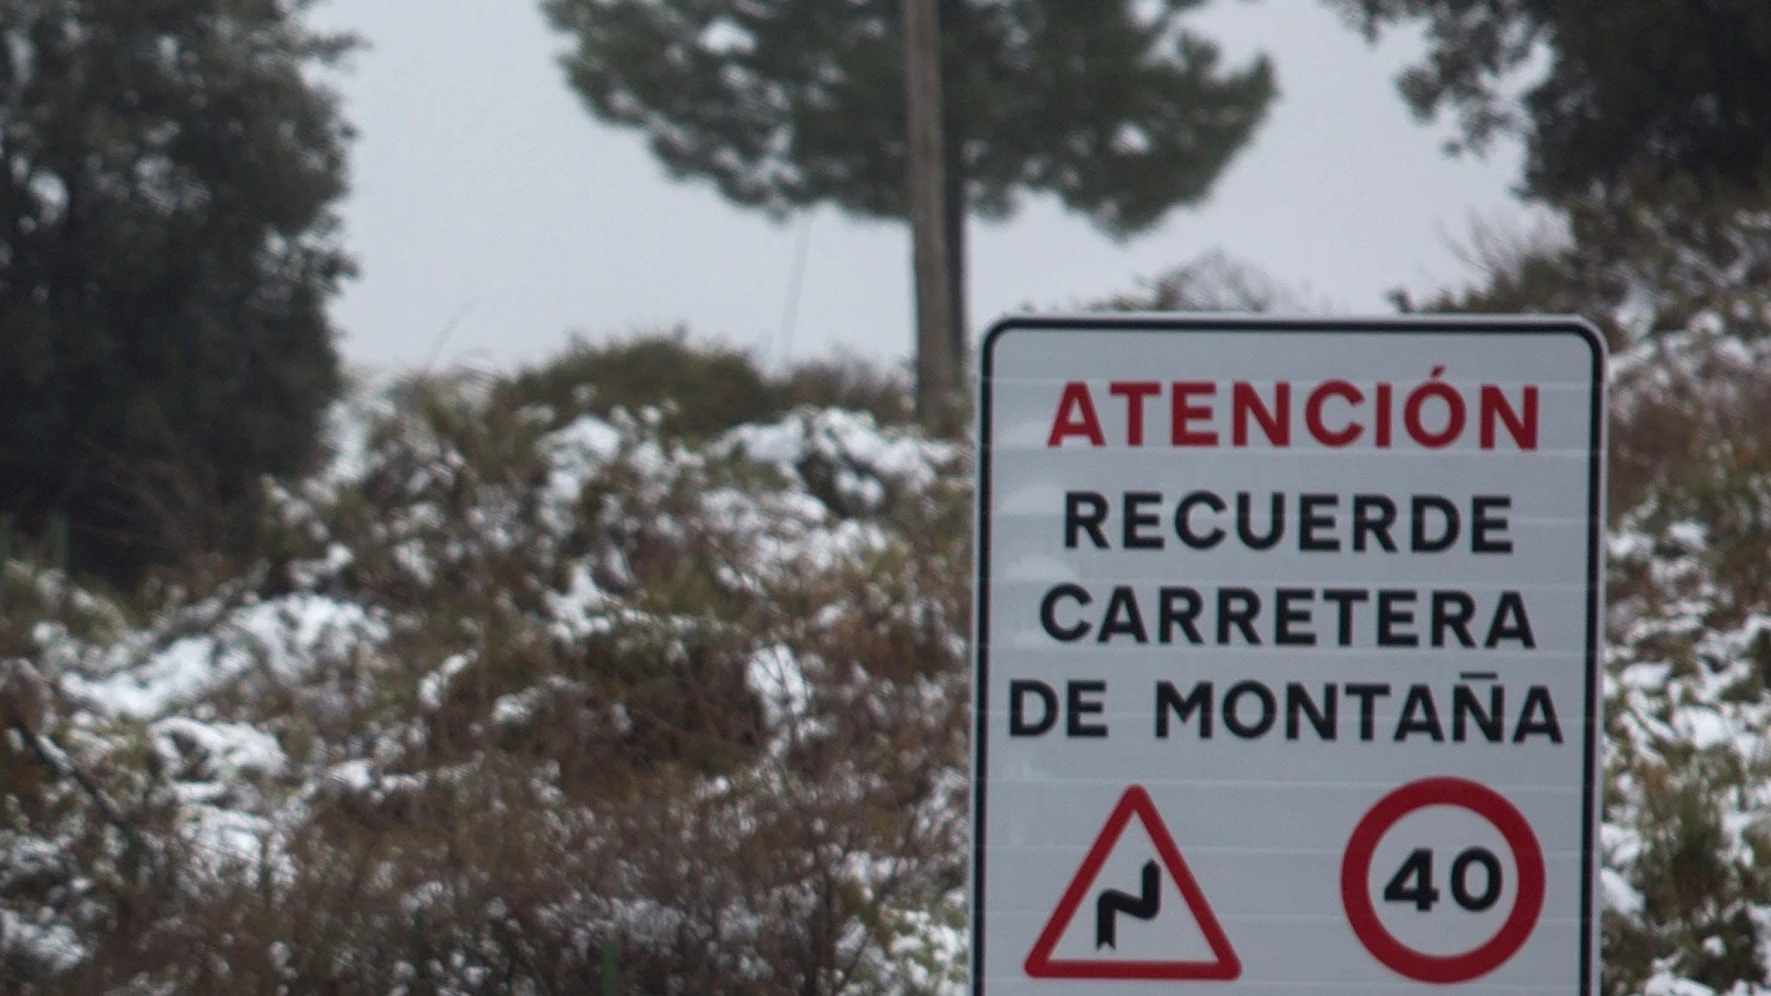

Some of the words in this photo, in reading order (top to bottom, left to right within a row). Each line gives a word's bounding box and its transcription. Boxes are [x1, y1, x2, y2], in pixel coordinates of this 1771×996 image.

[1048, 366, 1539, 450] ATENCIÓN
[1065, 491, 1514, 554] RECUERDE
[1040, 584, 1536, 650] CARRETERA
[1009, 680, 1109, 738] DE
[1155, 672, 1564, 745] MONTAÑA
[1383, 847, 1503, 912] 40
